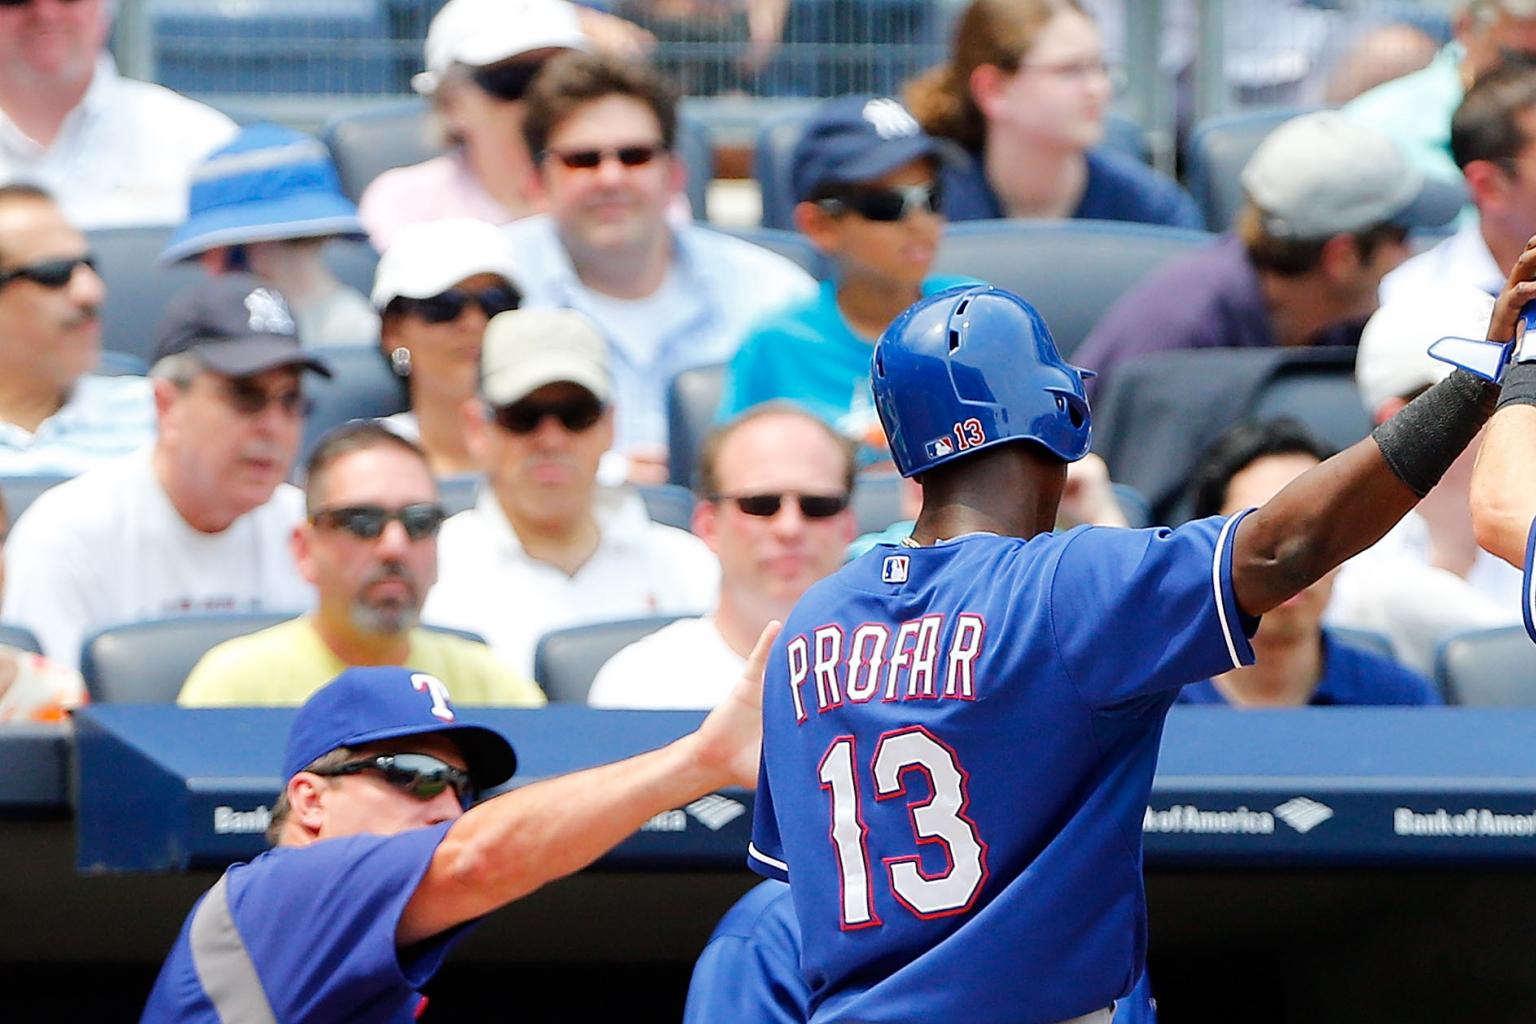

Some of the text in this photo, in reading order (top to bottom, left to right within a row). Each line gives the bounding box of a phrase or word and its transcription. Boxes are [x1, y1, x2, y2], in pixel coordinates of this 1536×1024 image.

[954, 418, 986, 450] 13
[410, 673, 456, 723] T
[787, 613, 986, 726] PROFAR
[817, 724, 989, 931] 13
